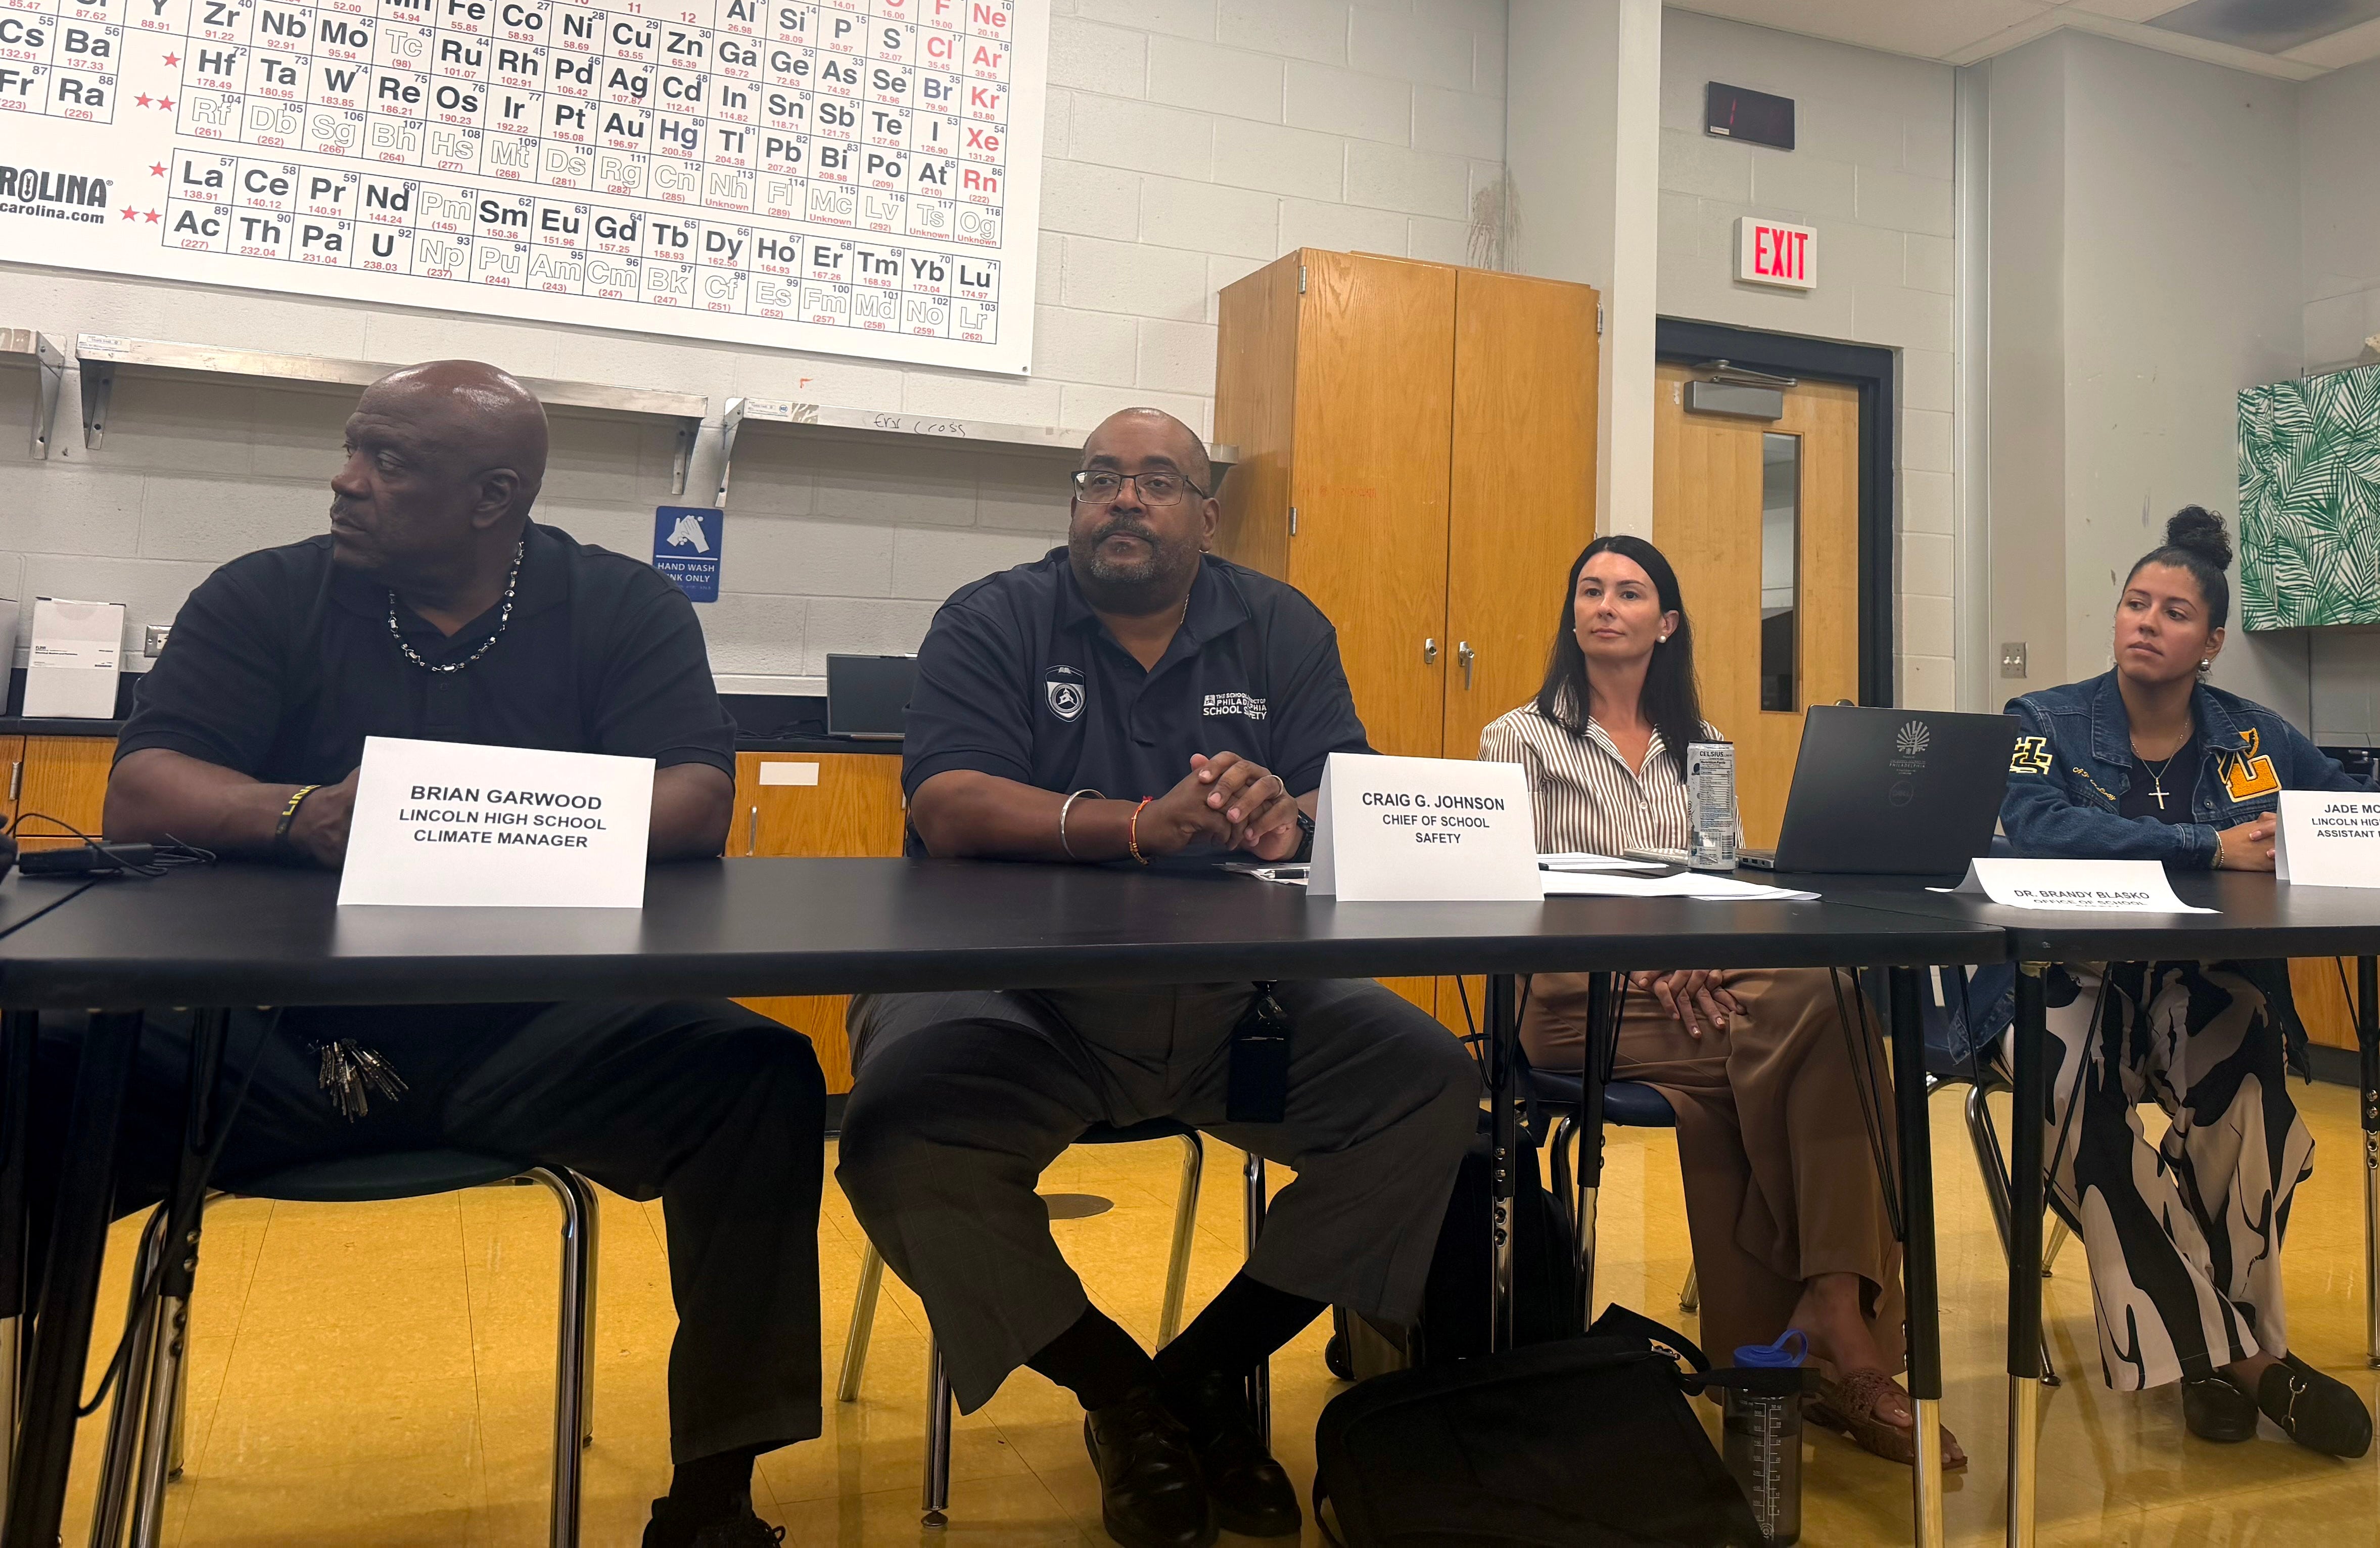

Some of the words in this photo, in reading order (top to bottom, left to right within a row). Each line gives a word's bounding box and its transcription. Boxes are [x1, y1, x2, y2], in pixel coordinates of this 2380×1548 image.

[203, 1, 241, 27] Zr
[502, 4, 543, 30] Co
[627, 2, 642, 14] 11
[680, 12, 697, 24] 12
[779, 7, 805, 32] Si
[972, 3, 1007, 28] Ne
[0, 19, 44, 47] Cs
[105, 26, 120, 36] 56
[261, 10, 306, 38] Nb
[320, 19, 368, 48] Mo
[507, 31, 534, 42] 58.93
[563, 13, 593, 39] Ni
[613, 22, 651, 49] Cu
[645, 20, 659, 30] 29
[834, 18, 852, 38] P
[65, 28, 110, 58] Ba
[267, 39, 295, 51] 92.91
[385, 28, 423, 57] Tc
[667, 31, 703, 58] Zn
[751, 39, 762, 48] 31
[883, 28, 901, 50] S
[67, 58, 104, 71] 137.33
[199, 49, 236, 76] Hf
[295, 55, 308, 65] 73
[441, 38, 482, 67] Ru
[498, 48, 538, 76] Rh
[532, 47, 546, 57] 45
[617, 49, 643, 60] 63.55
[719, 41, 757, 67] Ga
[771, 51, 809, 76] Ge
[972, 45, 1003, 69] Ar
[98, 75, 114, 85] 88
[198, 77, 232, 90] 178.49
[260, 58, 296, 86] Ta
[324, 67, 356, 94] W
[555, 58, 594, 85] Pd
[608, 67, 648, 99] Ag
[777, 76, 801, 87] 72.63
[821, 60, 857, 84] As
[872, 68, 907, 93] Se
[58, 77, 104, 107] Ra
[378, 76, 421, 104] Re
[436, 85, 478, 113] Os
[663, 76, 702, 102] Cd
[722, 85, 746, 110] In
[748, 83, 760, 92] 49
[924, 77, 953, 101] Br
[970, 86, 1001, 110] Kr
[996, 84, 1007, 93] 36
[440, 113, 472, 125] 190.23
[504, 96, 525, 119] Ir
[555, 104, 586, 129] Pt
[667, 102, 695, 114] 112.41
[768, 94, 804, 119] Sn
[819, 103, 855, 127] Sb
[250, 105, 297, 134] Db
[603, 112, 644, 138] Au
[871, 111, 902, 135] Te
[432, 131, 474, 160] Hs
[660, 118, 698, 150] Hg
[966, 127, 1000, 152] Xe
[219, 157, 235, 167] 57
[545, 148, 586, 176] Ds
[766, 137, 802, 162] Pb
[821, 146, 848, 170] Bi
[183, 160, 223, 188] La
[867, 153, 902, 178] Po
[918, 162, 948, 186] At
[992, 167, 1003, 176] 86
[244, 169, 289, 196] Ce
[310, 176, 346, 203] Pr
[871, 179, 894, 191] (209)
[963, 168, 998, 194] Rn
[248, 198, 282, 209] 140.12
[365, 184, 410, 212] Nd
[421, 191, 472, 220] Pm
[705, 198, 750, 211] Unknown
[173, 210, 220, 237] Ac
[276, 213, 291, 223] 90
[479, 200, 528, 227] Sm
[541, 208, 580, 234] Eu
[240, 216, 281, 244] Th
[302, 224, 342, 252] Pa
[487, 228, 519, 240] 150.36
[594, 215, 637, 242] Gd
[652, 222, 689, 248] Tb
[789, 235, 802, 244] 67
[240, 246, 276, 259] 232.04
[372, 233, 394, 257] U
[706, 230, 743, 260] Dy
[758, 237, 796, 262] Ho
[814, 245, 844, 268] Er
[1755, 225, 1808, 281] EXIT
[479, 246, 520, 274] Pu
[857, 251, 898, 276] Tm
[910, 258, 945, 282] Yb
[813, 270, 842, 281] 167.26
[960, 264, 991, 288] Lu
[756, 281, 791, 305] Es
[906, 300, 944, 325] No
[658, 562, 685, 571] HAND
[687, 564, 715, 572] WASH
[685, 574, 710, 582] ONLY
[1203, 705, 1242, 716] SCHOOL
[410, 785, 480, 802] BRIAN
[487, 789, 601, 810] GARWOOD
[1362, 792, 1410, 807] CRAIG
[1415, 794, 1430, 807] G.
[1434, 795, 1505, 811] JOHNSON
[2324, 804, 2359, 813] JADE
[399, 808, 479, 823] LINCOLN
[484, 812, 528, 826] HIGH
[533, 814, 606, 830] SCHOOL
[1382, 814, 1418, 825] CHIEF
[1421, 815, 1437, 826] OF
[1440, 816, 1490, 828] SCHOOL
[414, 829, 492, 844] CLIMATE
[497, 832, 588, 848] MANAGER
[1415, 832, 1461, 844] SAFETY
[2317, 830, 2375, 838] ASSISTANT
